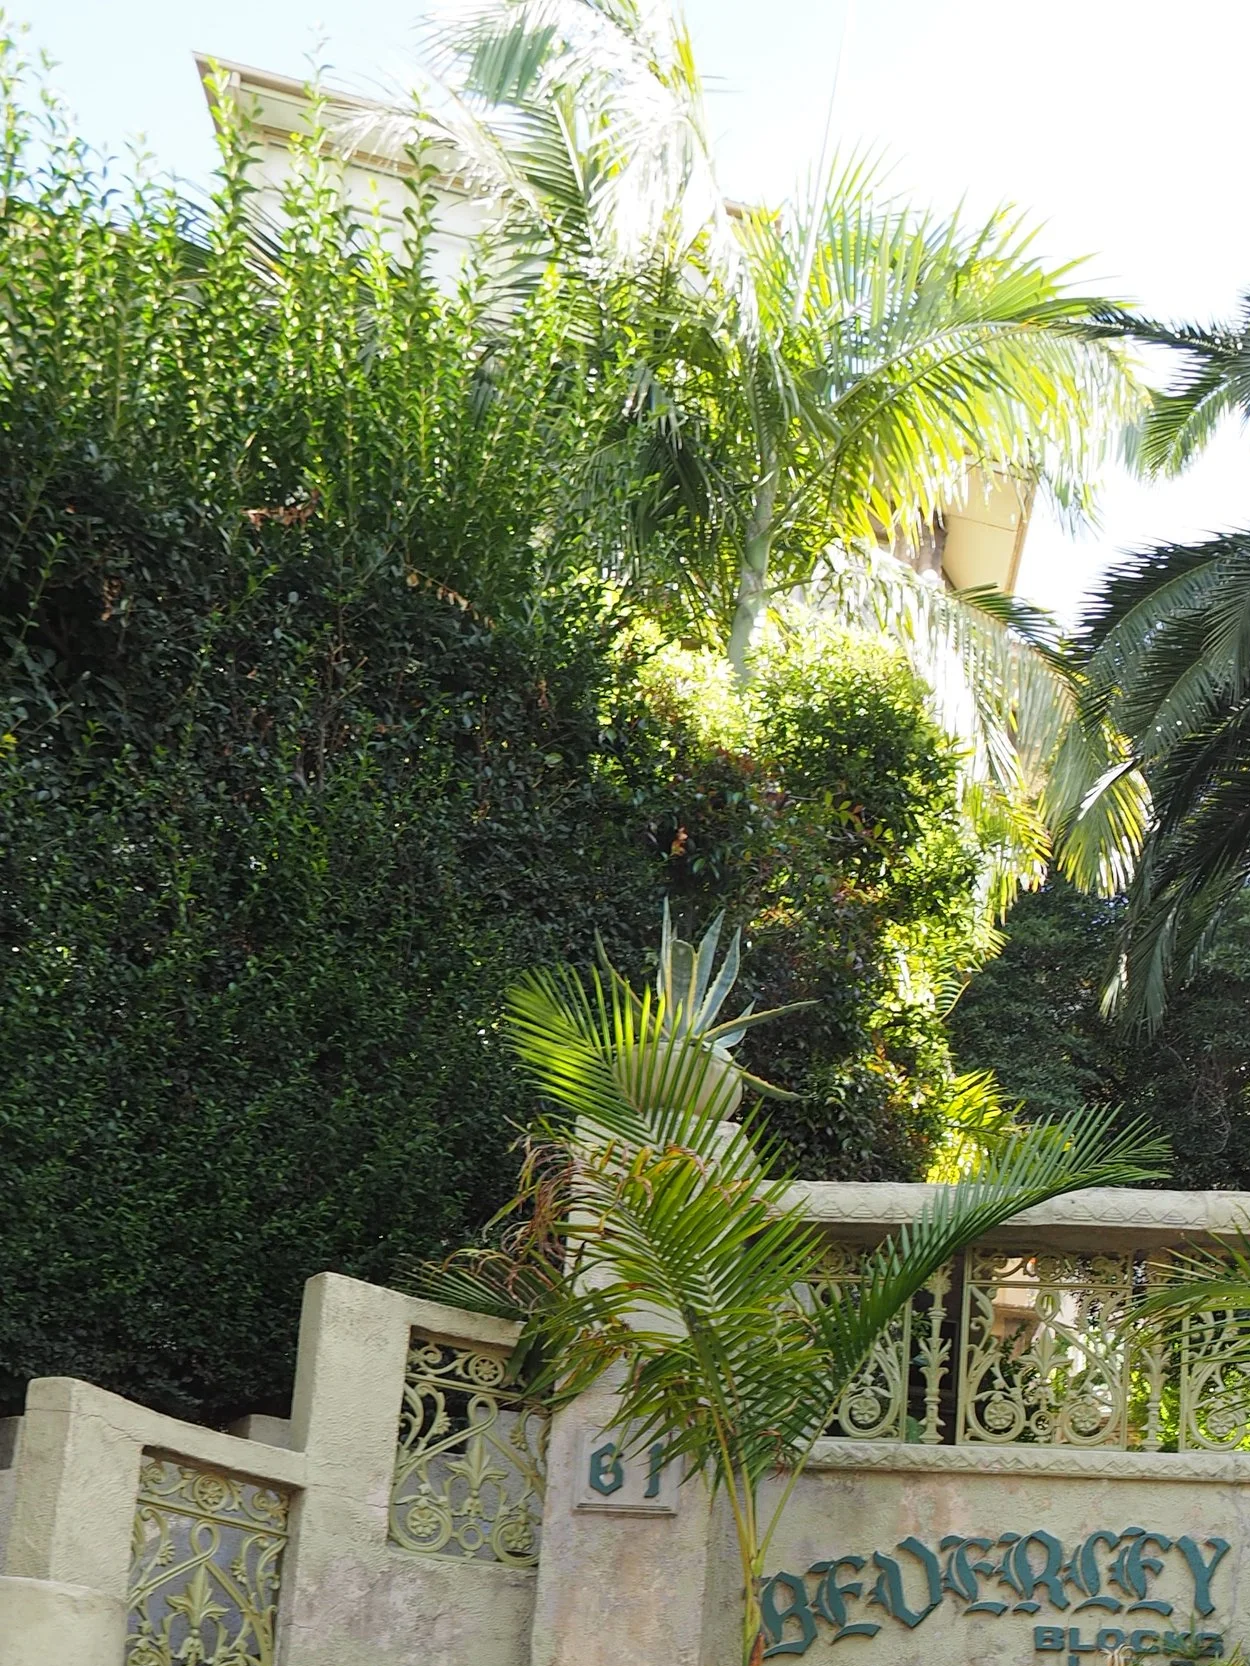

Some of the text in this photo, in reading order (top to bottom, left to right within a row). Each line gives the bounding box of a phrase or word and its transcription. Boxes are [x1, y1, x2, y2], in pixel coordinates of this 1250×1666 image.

[589, 1442, 665, 1498] 61
[760, 1526, 1231, 1659] BEVERLEY
[1033, 1625, 1225, 1657] BLOCKS
